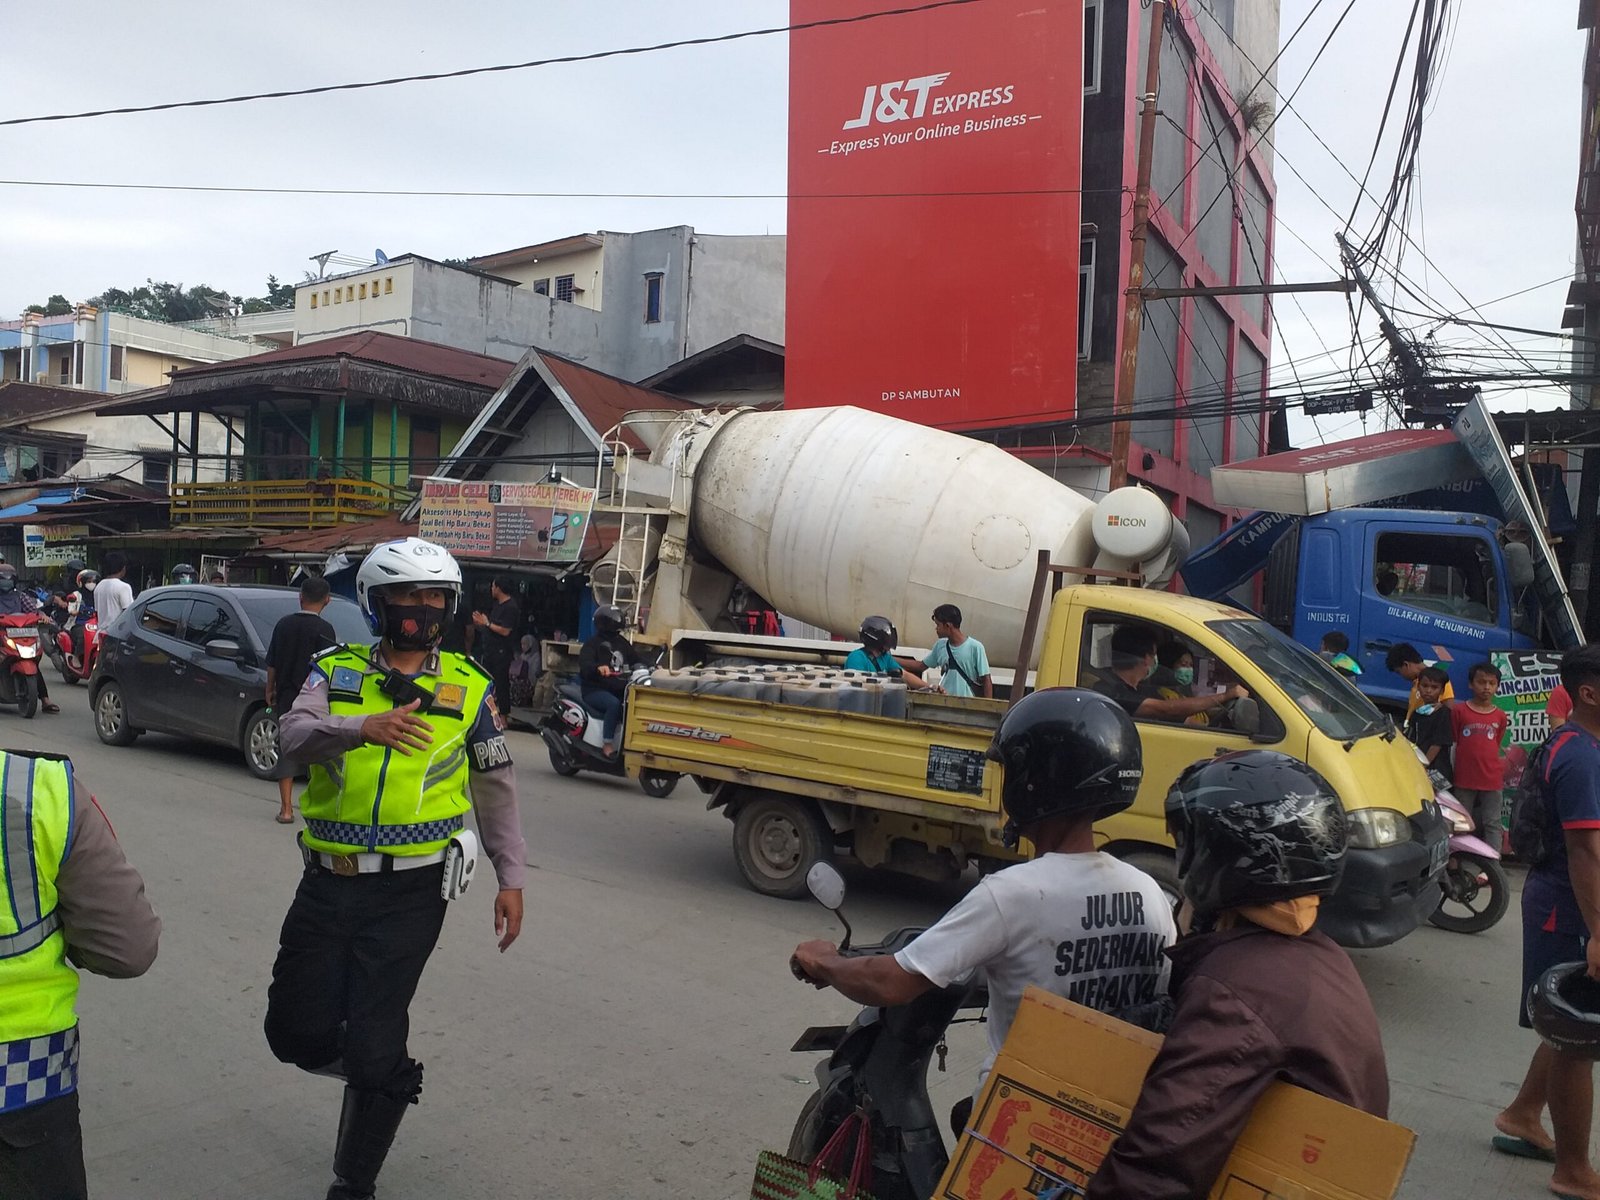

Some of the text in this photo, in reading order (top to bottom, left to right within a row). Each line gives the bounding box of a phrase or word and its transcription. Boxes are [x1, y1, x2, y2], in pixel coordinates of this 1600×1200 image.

[843, 72, 1014, 130] J&T EXPRESS
[882, 132, 913, 146] Your
[914, 123, 960, 141] Online
[881, 387, 961, 401] DP SAMBUTAN
[461, 484, 488, 498] CELL
[502, 485, 523, 498] SERVIS
[523, 486, 551, 500] SEGALA
[581, 491, 593, 503] HP
[422, 508, 492, 519] Aksesoris Hp Lengkap
[1119, 517, 1147, 528] ICON
[421, 519, 433, 527] Jual
[446, 520, 456, 529] Hp
[454, 531, 462, 541] Hp
[1307, 612, 1349, 623] INDUSTRI
[1387, 606, 1486, 640] DILARANG MENUMPANG
[647, 721, 732, 742] master
[1081, 891, 1145, 930] JUJUR
[1056, 1090, 1121, 1124] MERK TERDAFTAR
[1048, 1106, 1112, 1142] SEMARANG
